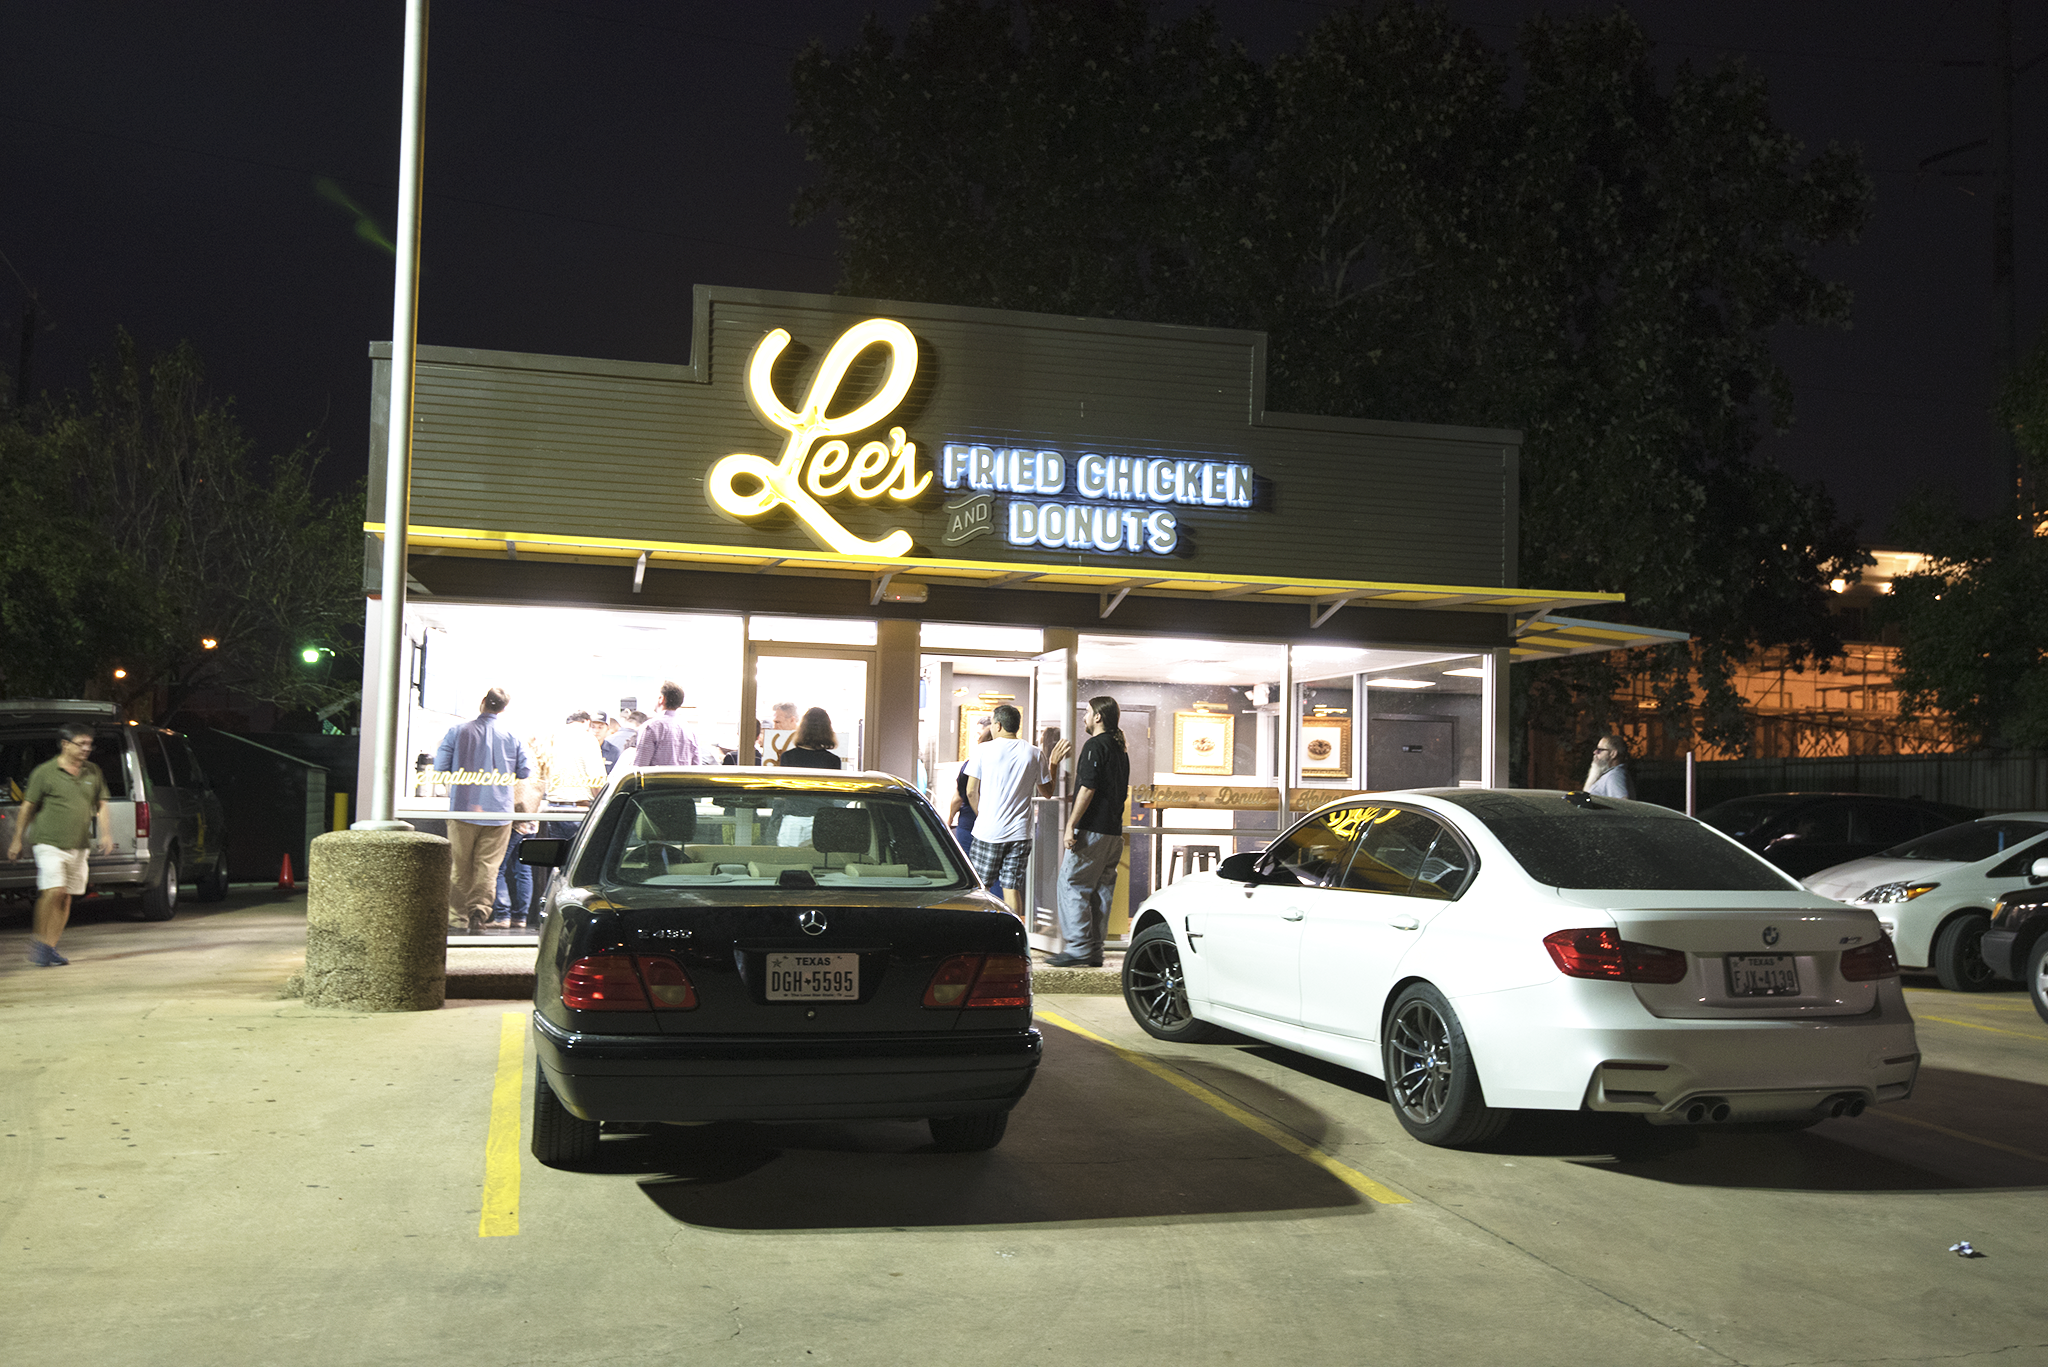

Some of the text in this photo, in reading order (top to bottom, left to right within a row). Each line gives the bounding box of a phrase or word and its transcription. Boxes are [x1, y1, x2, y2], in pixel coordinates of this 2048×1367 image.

[704, 317, 934, 558] Lee's
[943, 445, 1254, 508] FRIED CHICKEN
[951, 501, 1178, 554] AND DONUTS
[416, 764, 519, 788] Sandwiches
[1133, 784, 1190, 803] Chicken
[1215, 786, 1270, 805] Donuts
[795, 957, 831, 966] TEXAS
[1748, 958, 1775, 966] TEXAS
